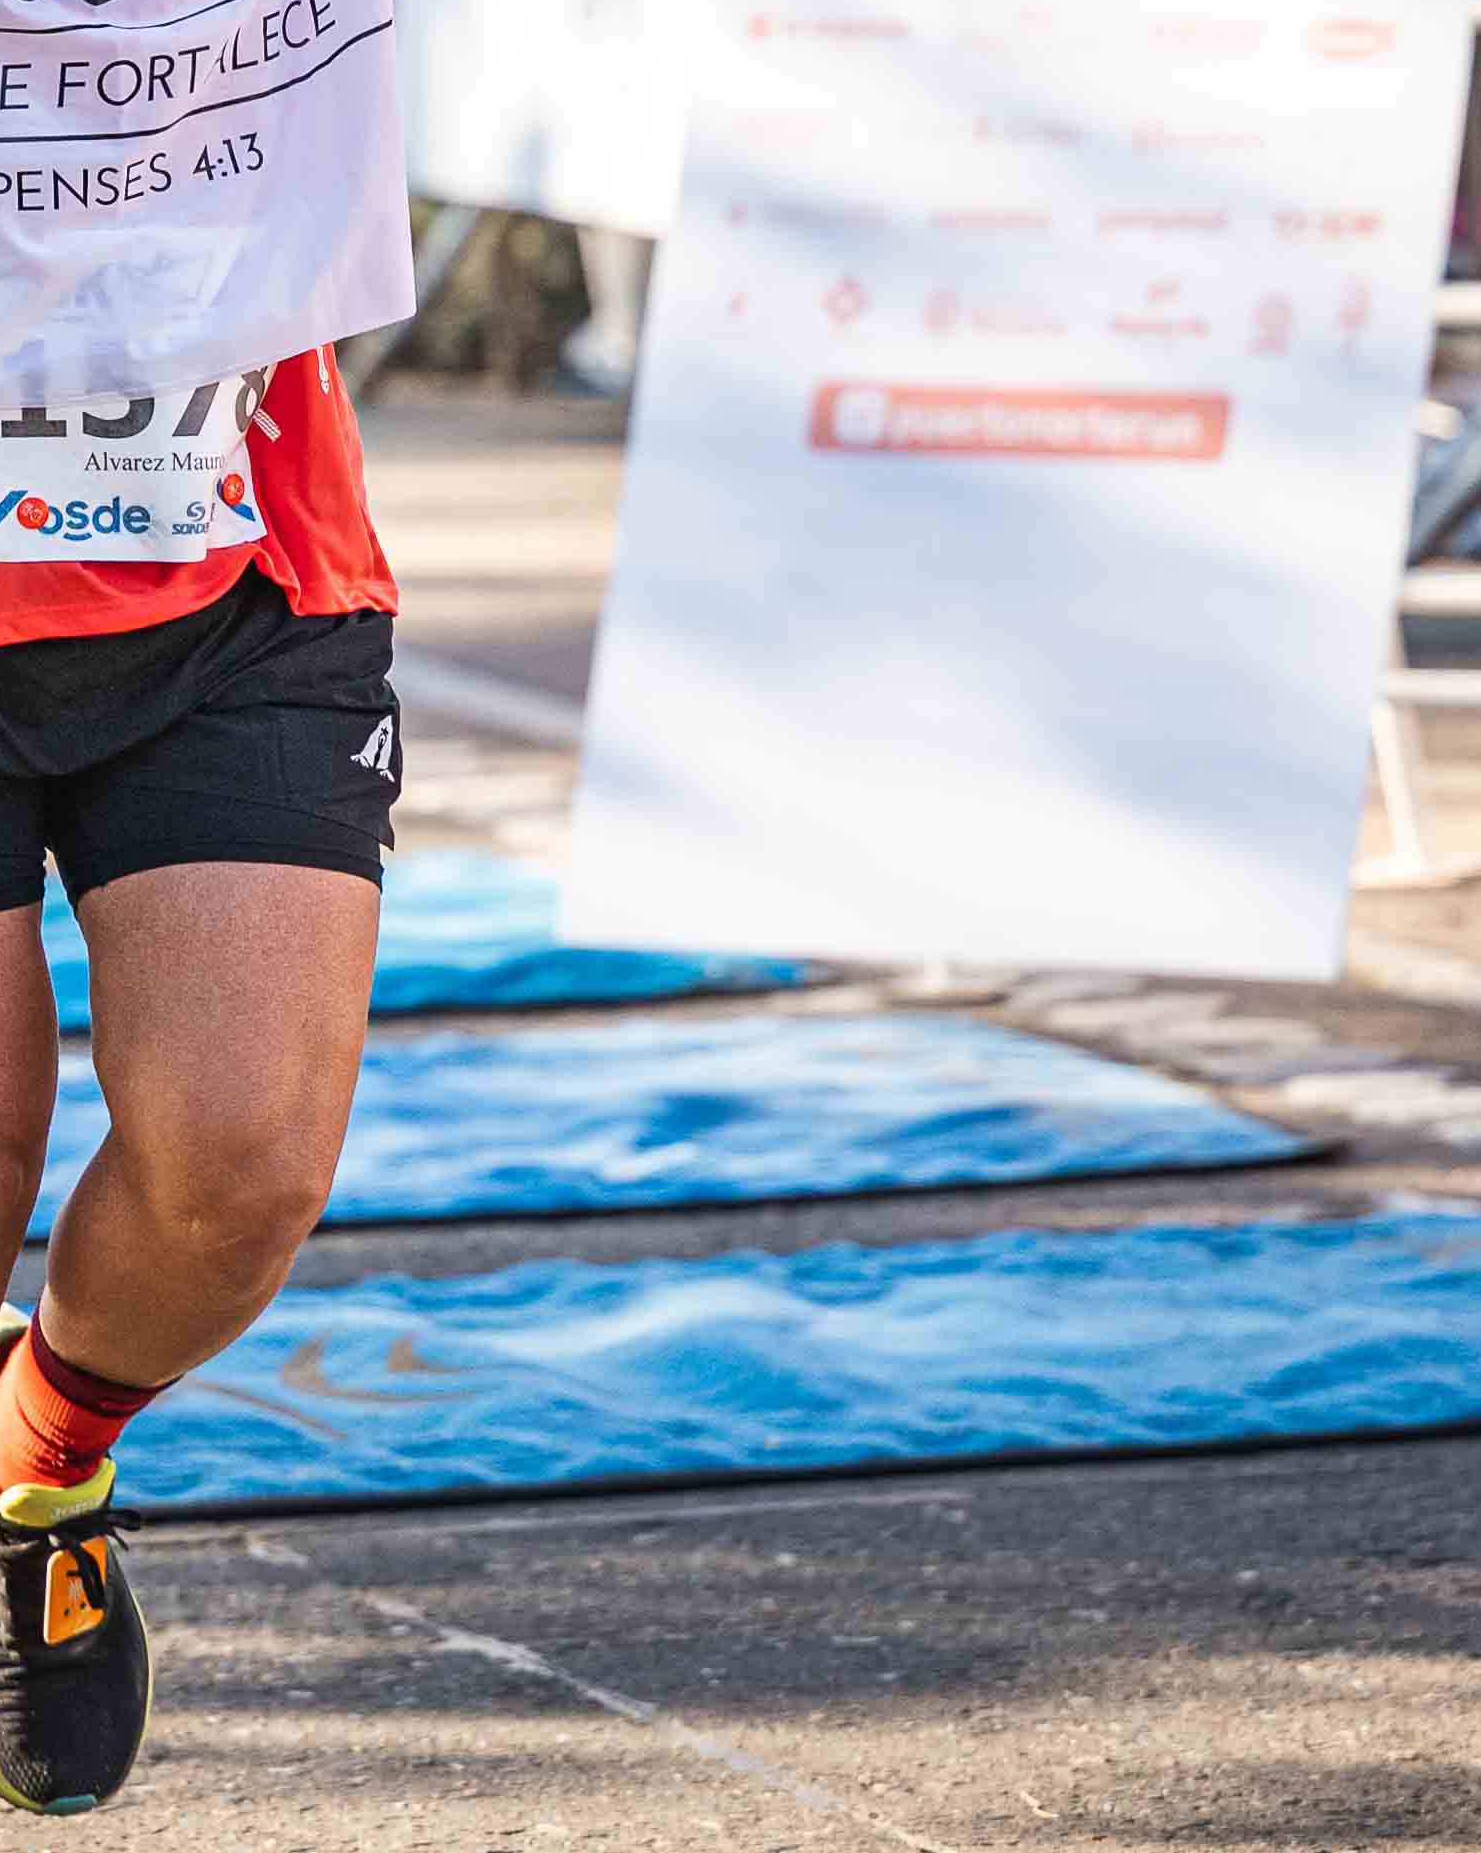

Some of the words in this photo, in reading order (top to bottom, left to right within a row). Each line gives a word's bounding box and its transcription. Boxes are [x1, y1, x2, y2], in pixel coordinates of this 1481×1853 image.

[192, 132, 266, 182] 4:13
[83, 452, 165, 472] Alvarez
[171, 452, 224, 472] Maur
[36, 495, 151, 535] osde
